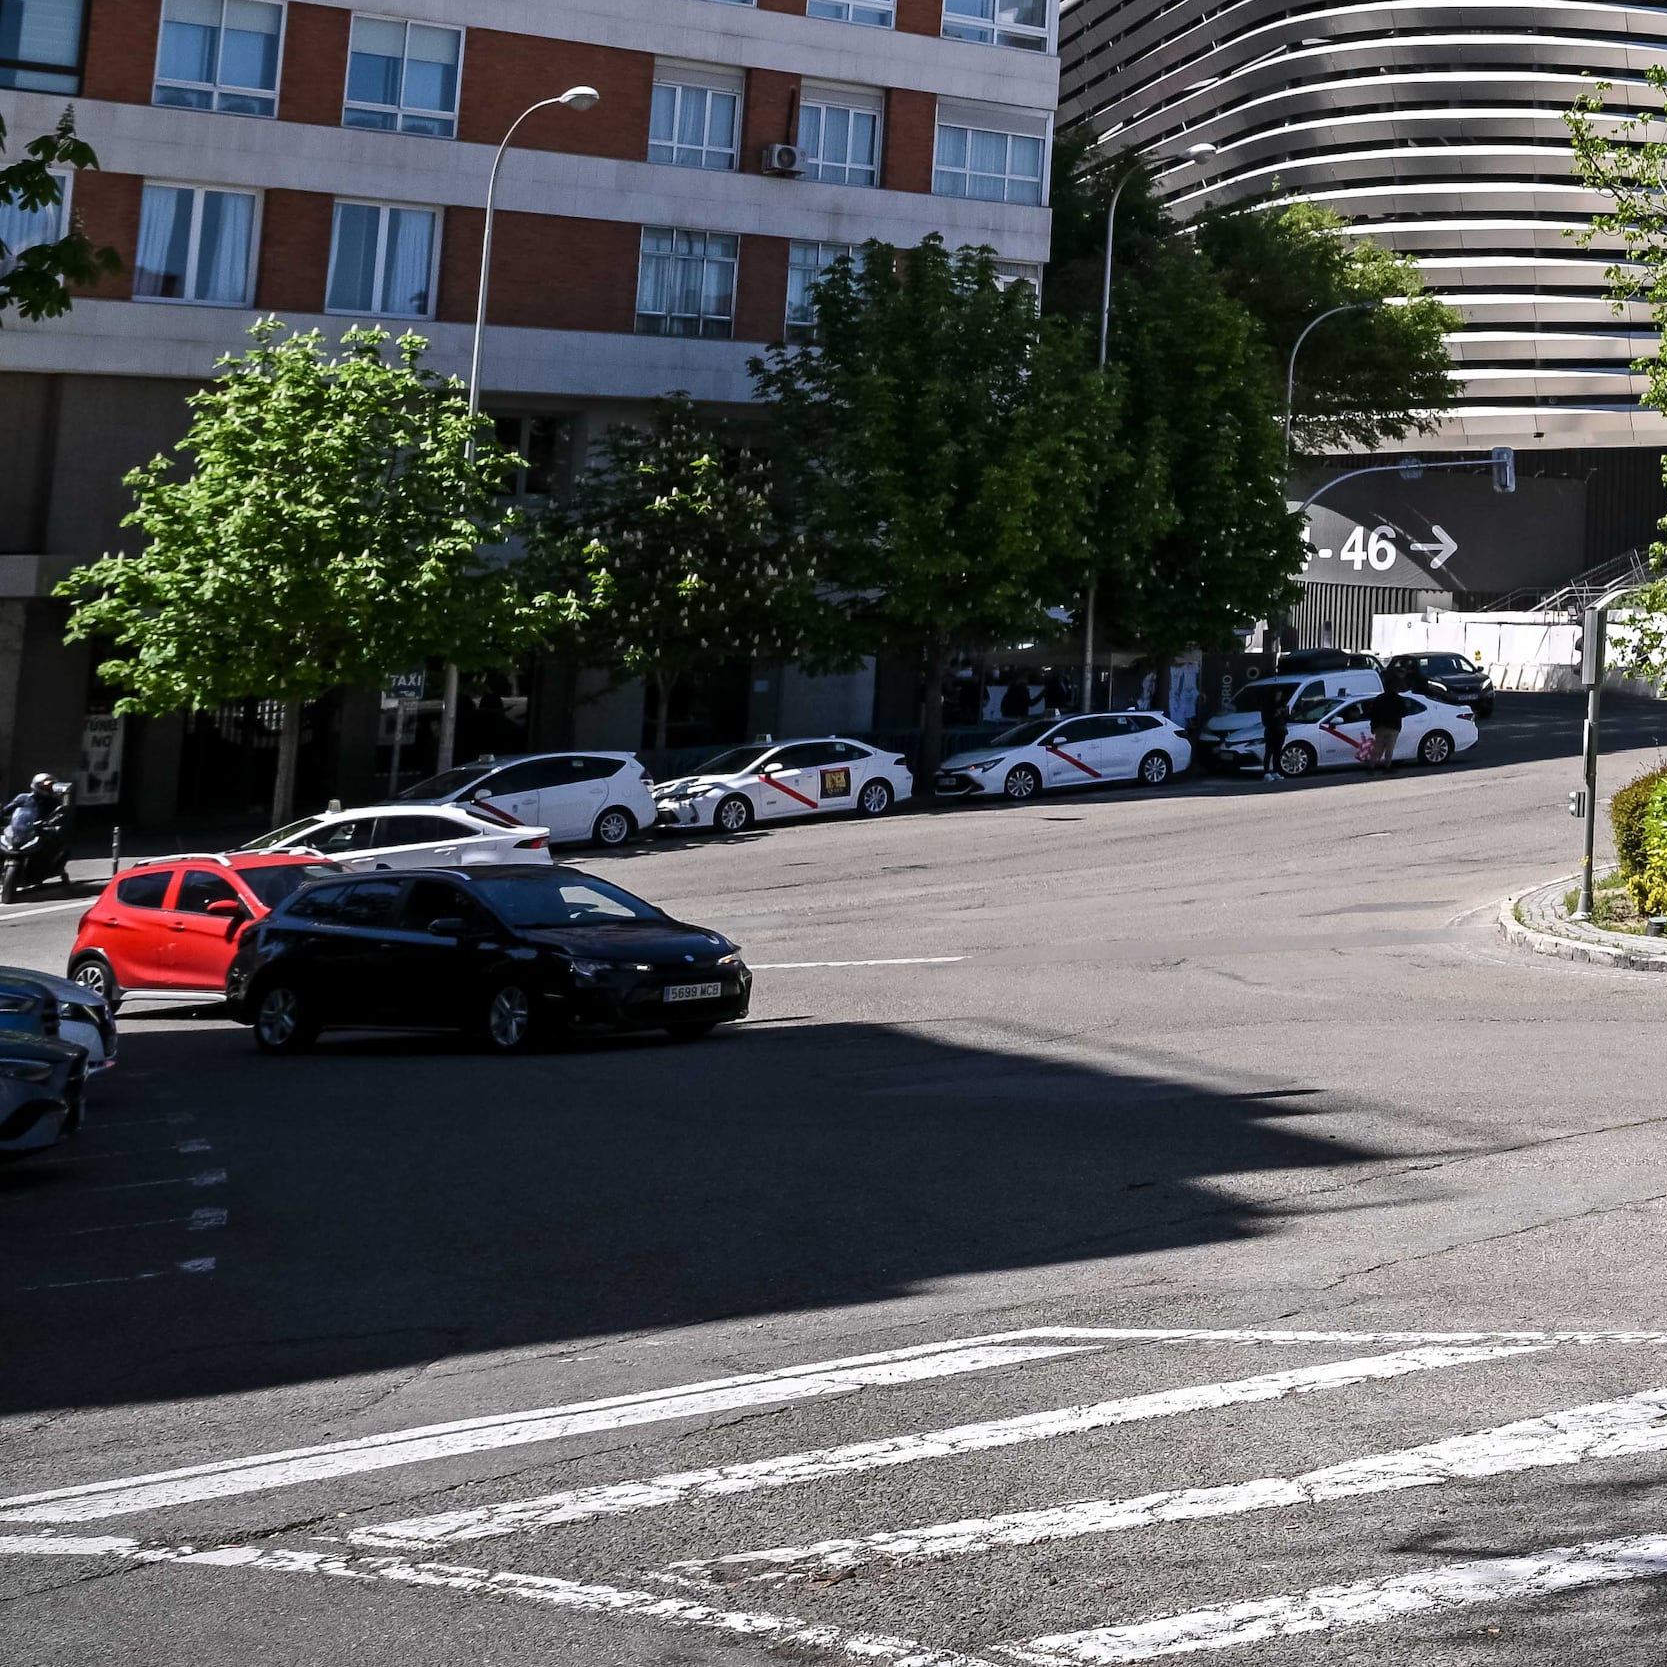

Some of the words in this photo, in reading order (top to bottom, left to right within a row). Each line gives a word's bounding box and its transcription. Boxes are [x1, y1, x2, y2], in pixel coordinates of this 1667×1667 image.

[1340, 524, 1397, 571] 46
[389, 673, 422, 687] TAXI
[671, 986, 698, 1000] 5699
